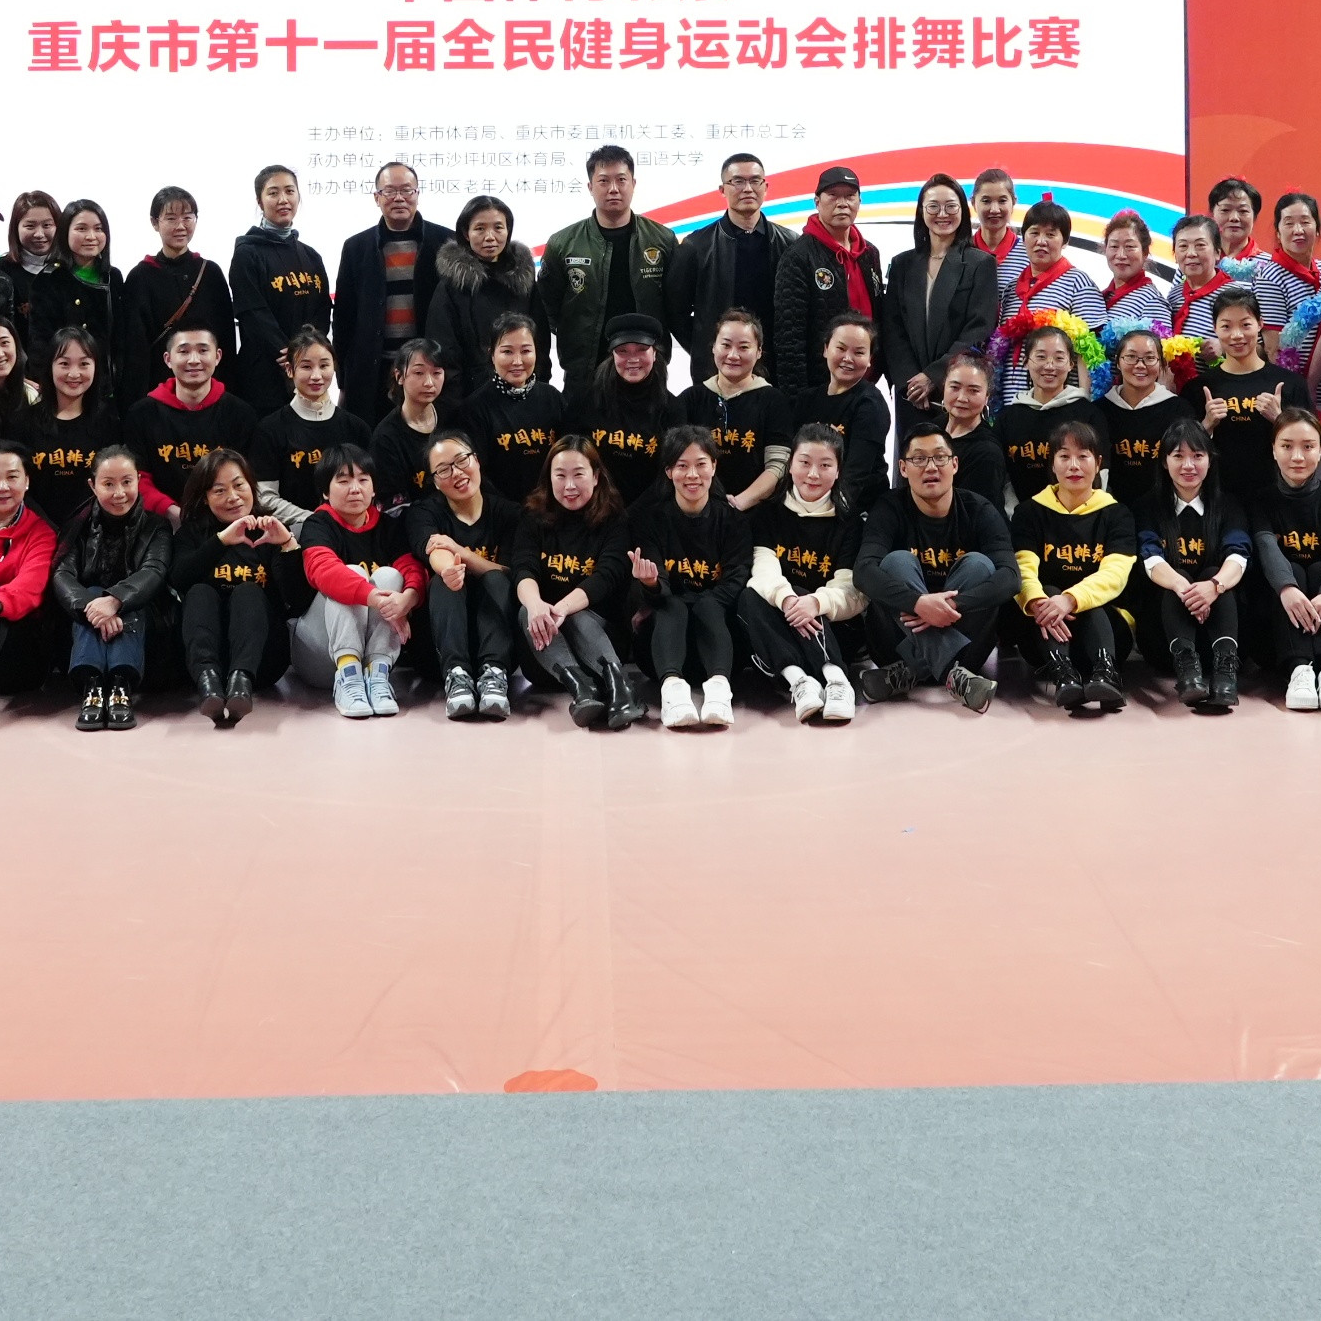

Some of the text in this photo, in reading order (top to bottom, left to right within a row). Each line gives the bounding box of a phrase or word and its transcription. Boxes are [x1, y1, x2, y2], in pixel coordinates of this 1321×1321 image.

[27, 17, 1080, 72] 重庆市第十一届全民健身运动会排舞比赛
[157, 442, 225, 462] 中国排
[592, 429, 658, 457] 中国排舞
[711, 428, 756, 453] 国排舞
[1008, 440, 1050, 462] 中国排
[214, 563, 267, 587] 国排舞
[541, 552, 596, 576] 国排舞
